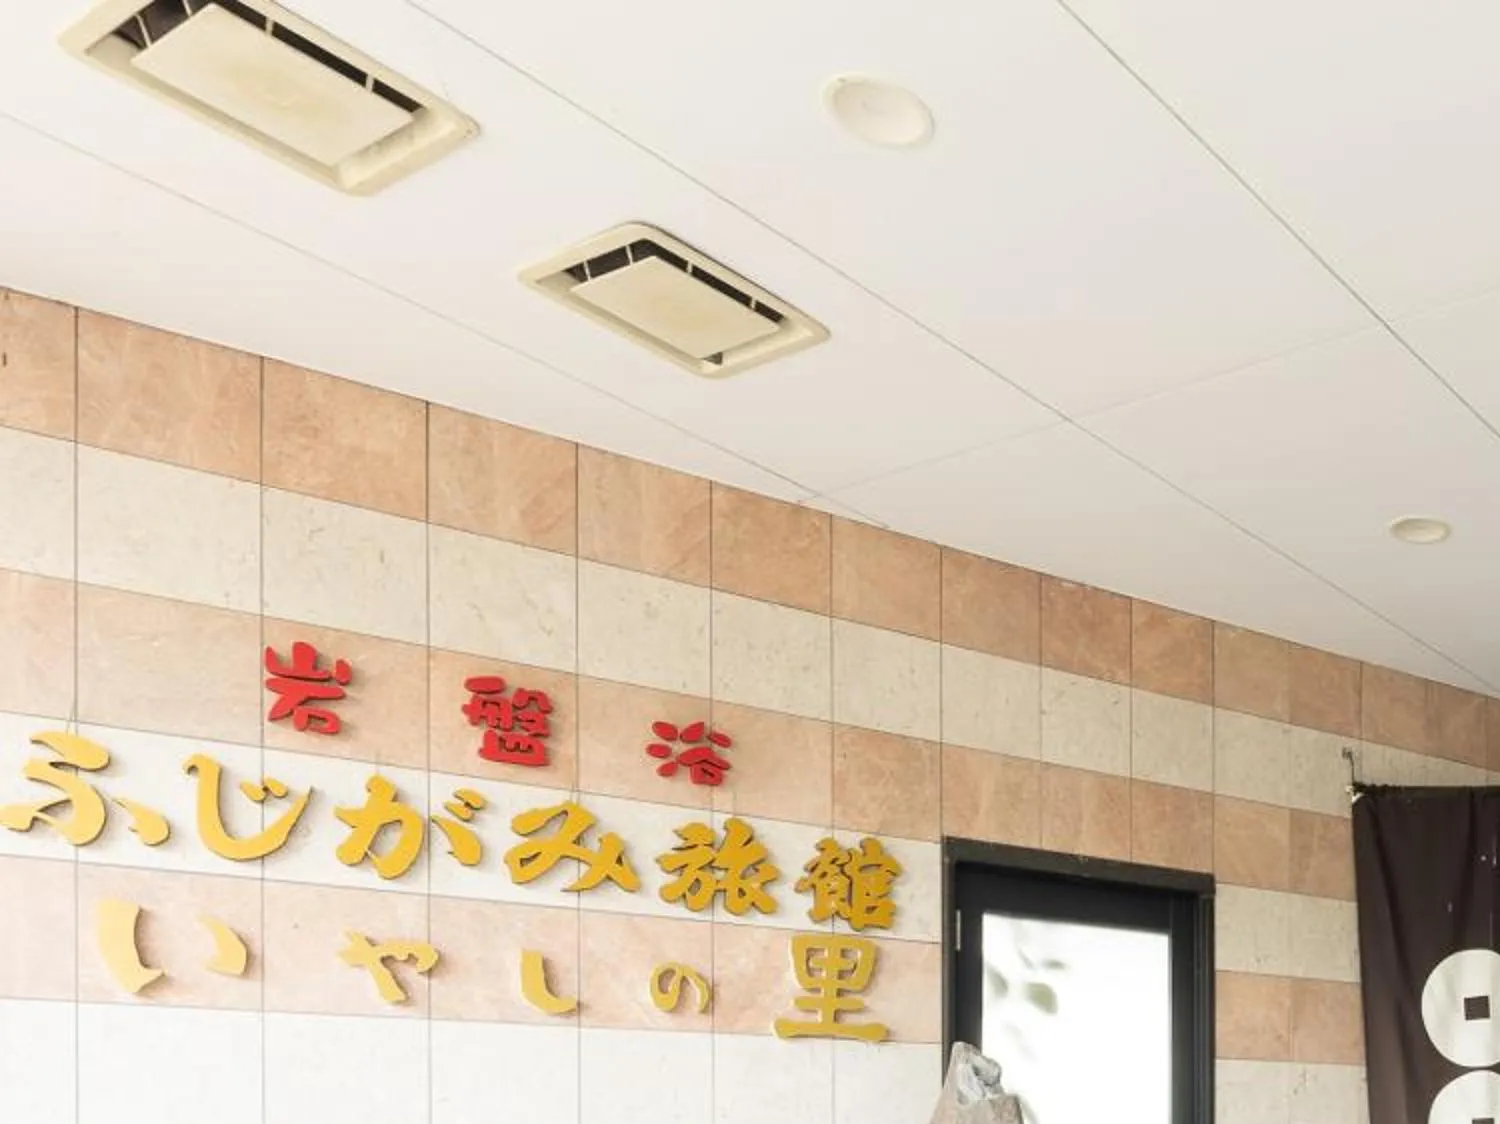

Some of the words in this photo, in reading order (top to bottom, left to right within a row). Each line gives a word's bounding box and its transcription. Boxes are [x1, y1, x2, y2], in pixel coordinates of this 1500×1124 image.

[265, 640, 733, 787] 岩盤浴
[0, 731, 904, 933] ふじがみ旅館
[97, 898, 890, 1043] いやしの里
